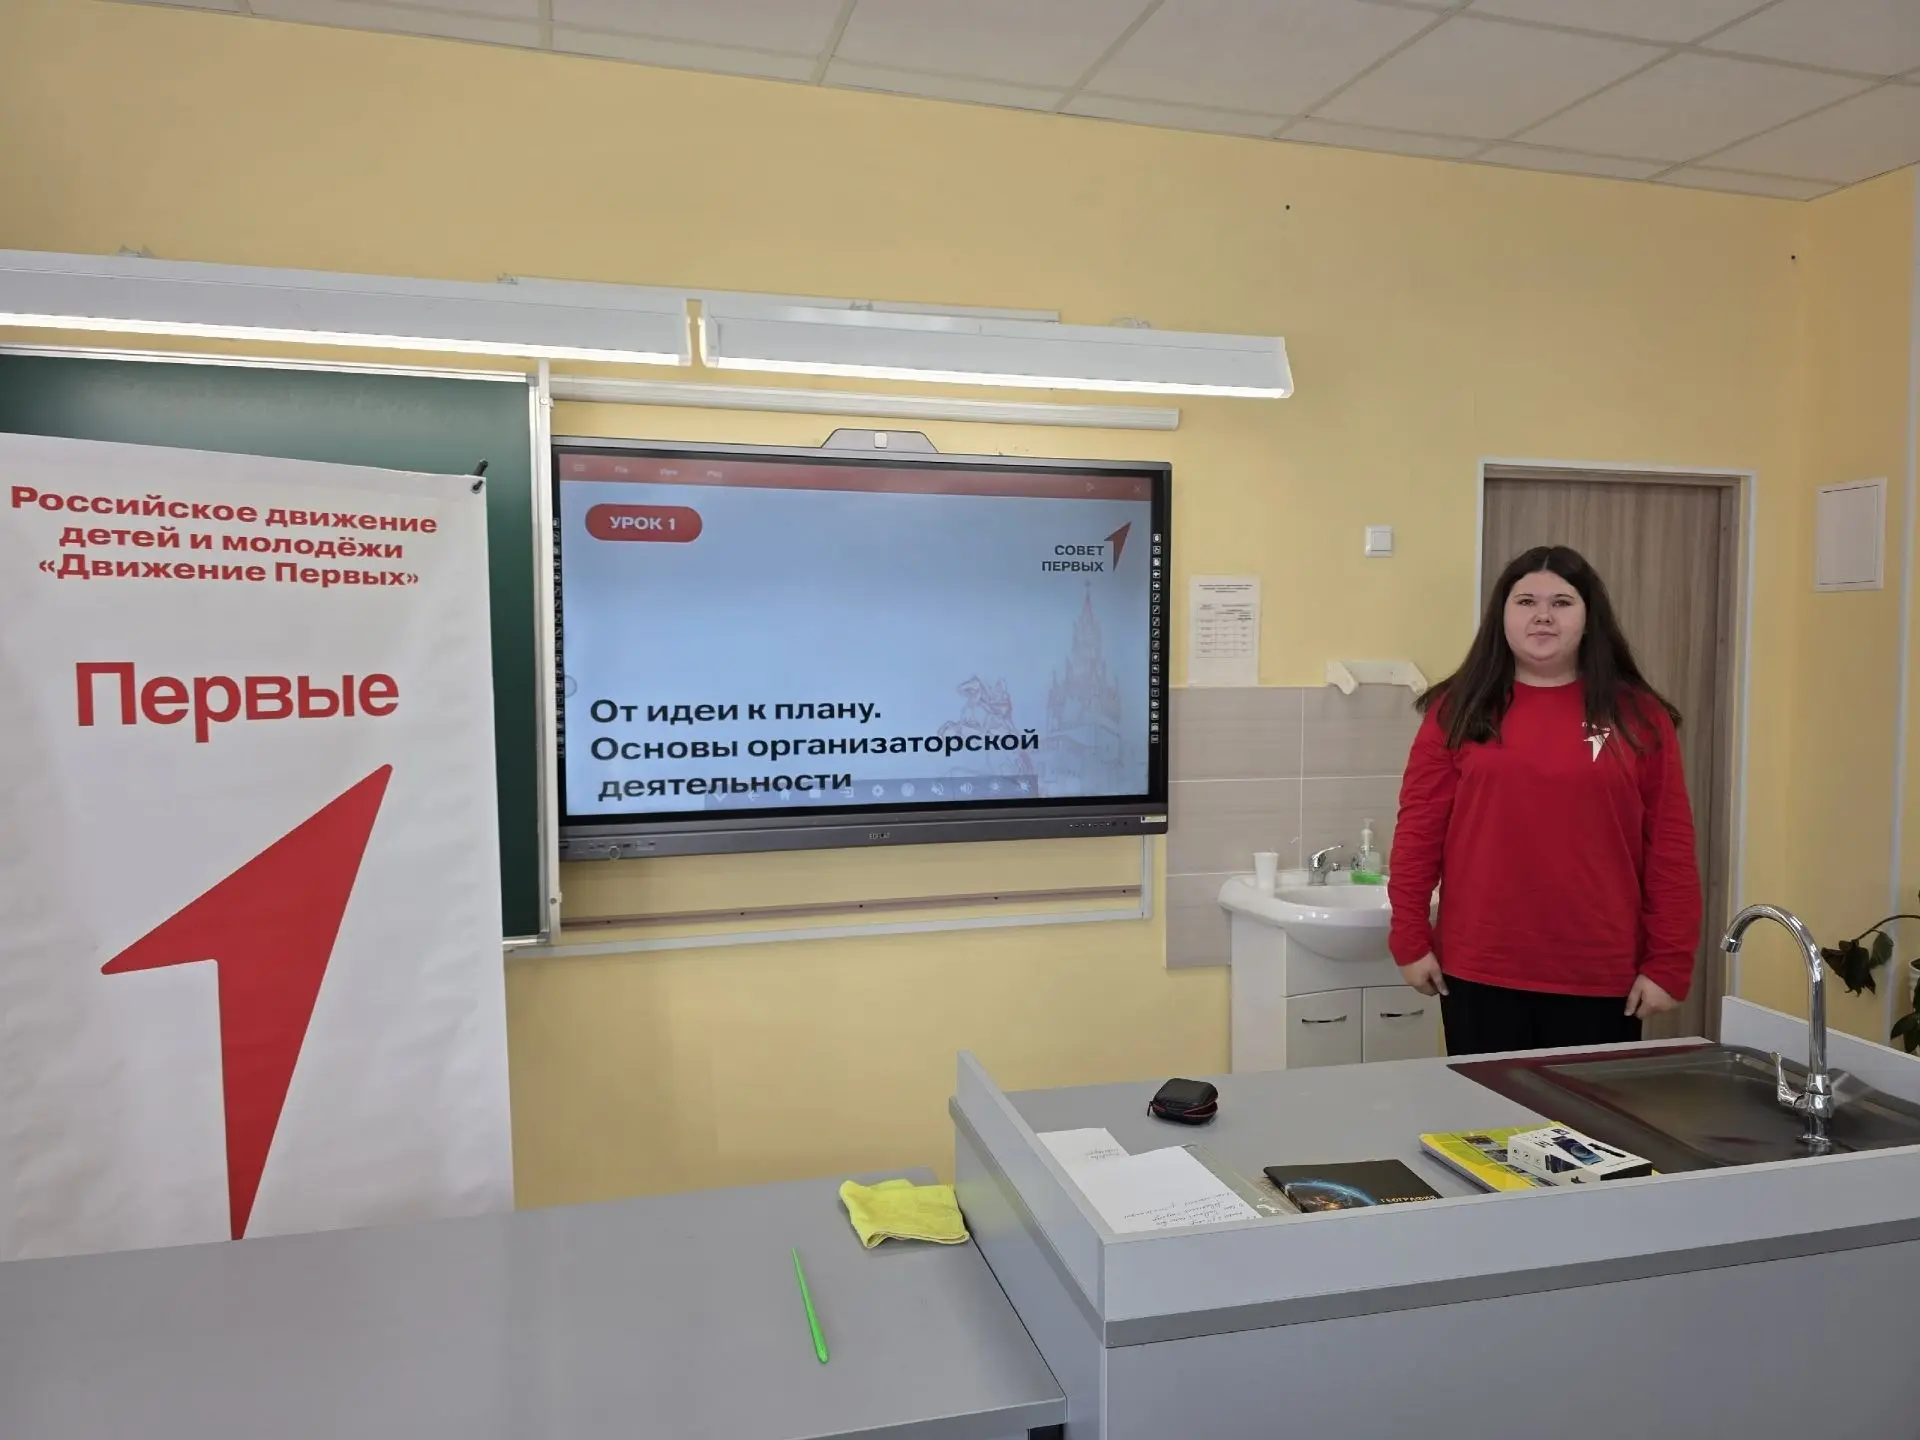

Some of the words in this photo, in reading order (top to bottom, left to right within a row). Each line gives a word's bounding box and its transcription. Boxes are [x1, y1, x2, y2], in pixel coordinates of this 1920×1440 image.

[12, 486, 257, 521] Российское
[265, 509, 438, 533] движение
[609, 516, 663, 530] УРОК
[668, 517, 675, 530] 1
[60, 526, 180, 549] детей
[190, 534, 212, 550] и
[223, 537, 403, 558] молодёжи
[1055, 545, 1104, 556] СОВЕТ
[38, 553, 267, 582] «Движение
[276, 562, 420, 588] Первых»
[1042, 561, 1104, 572] ПЕРВЫХ
[76, 662, 399, 743] Первые
[591, 700, 637, 722] От
[648, 705, 737, 725] идеи
[749, 704, 766, 719] к
[776, 703, 880, 723] плану.
[592, 738, 737, 760] Основы
[748, 729, 1038, 760] организаторской
[598, 774, 851, 801] деятельности
